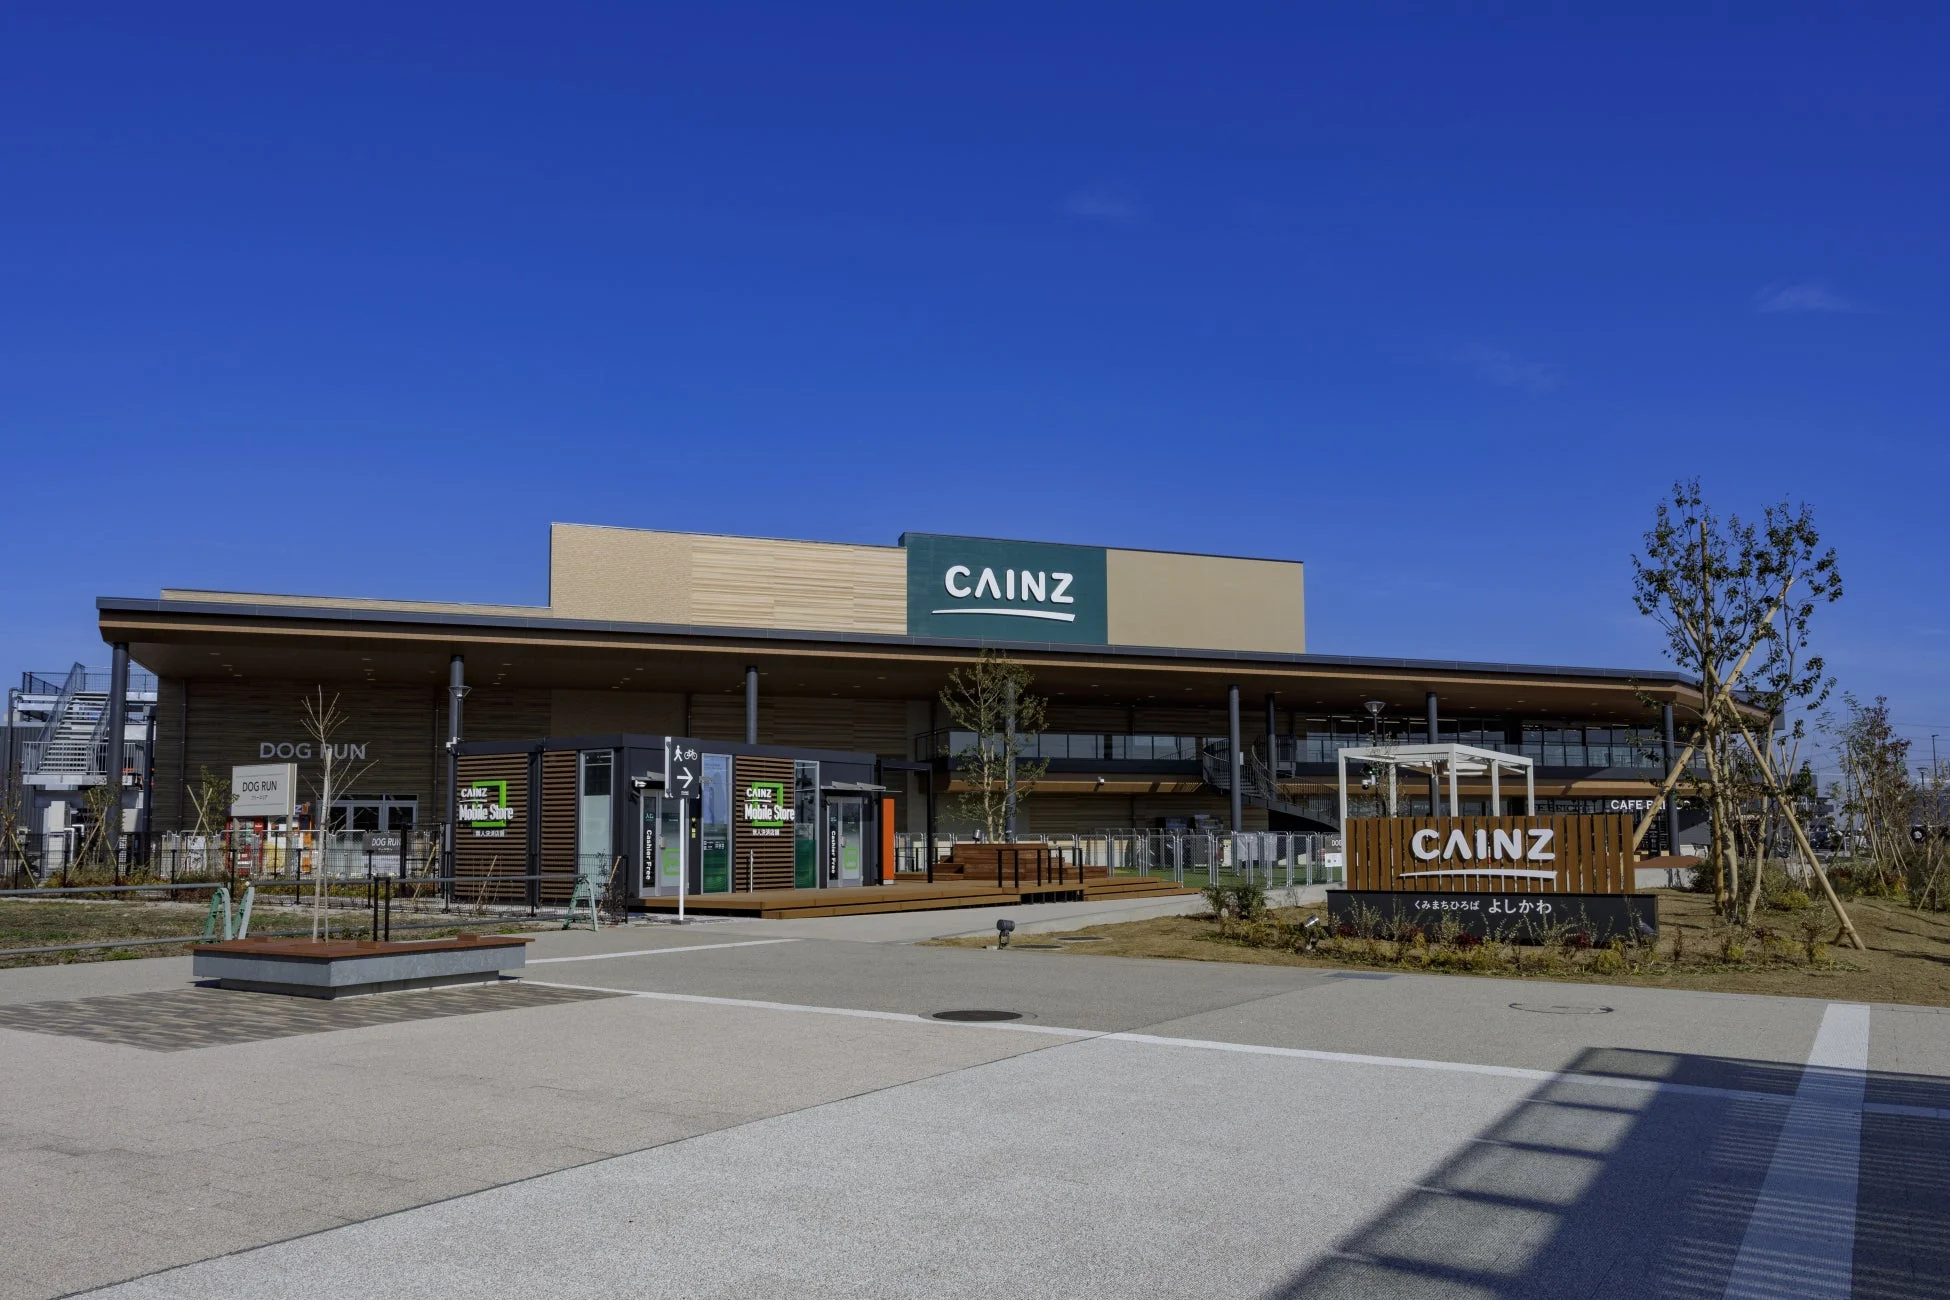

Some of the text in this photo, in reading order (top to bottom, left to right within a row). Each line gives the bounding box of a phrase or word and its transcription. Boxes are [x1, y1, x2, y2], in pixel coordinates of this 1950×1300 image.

[945, 565, 1074, 604] CAINZ
[260, 742, 312, 759] DOG
[242, 780, 277, 792] DOG RUN
[460, 787, 487, 798] CAINZ
[746, 788, 772, 798] CAINZ
[459, 804, 514, 820] Mobile Store
[744, 803, 795, 820] Mobile Store
[1611, 799, 1643, 810] CAFE
[371, 837, 386, 847] DOG
[1411, 828, 1556, 860] CAINZ
[1414, 898, 1552, 915] くみまちひろば よしかわ
